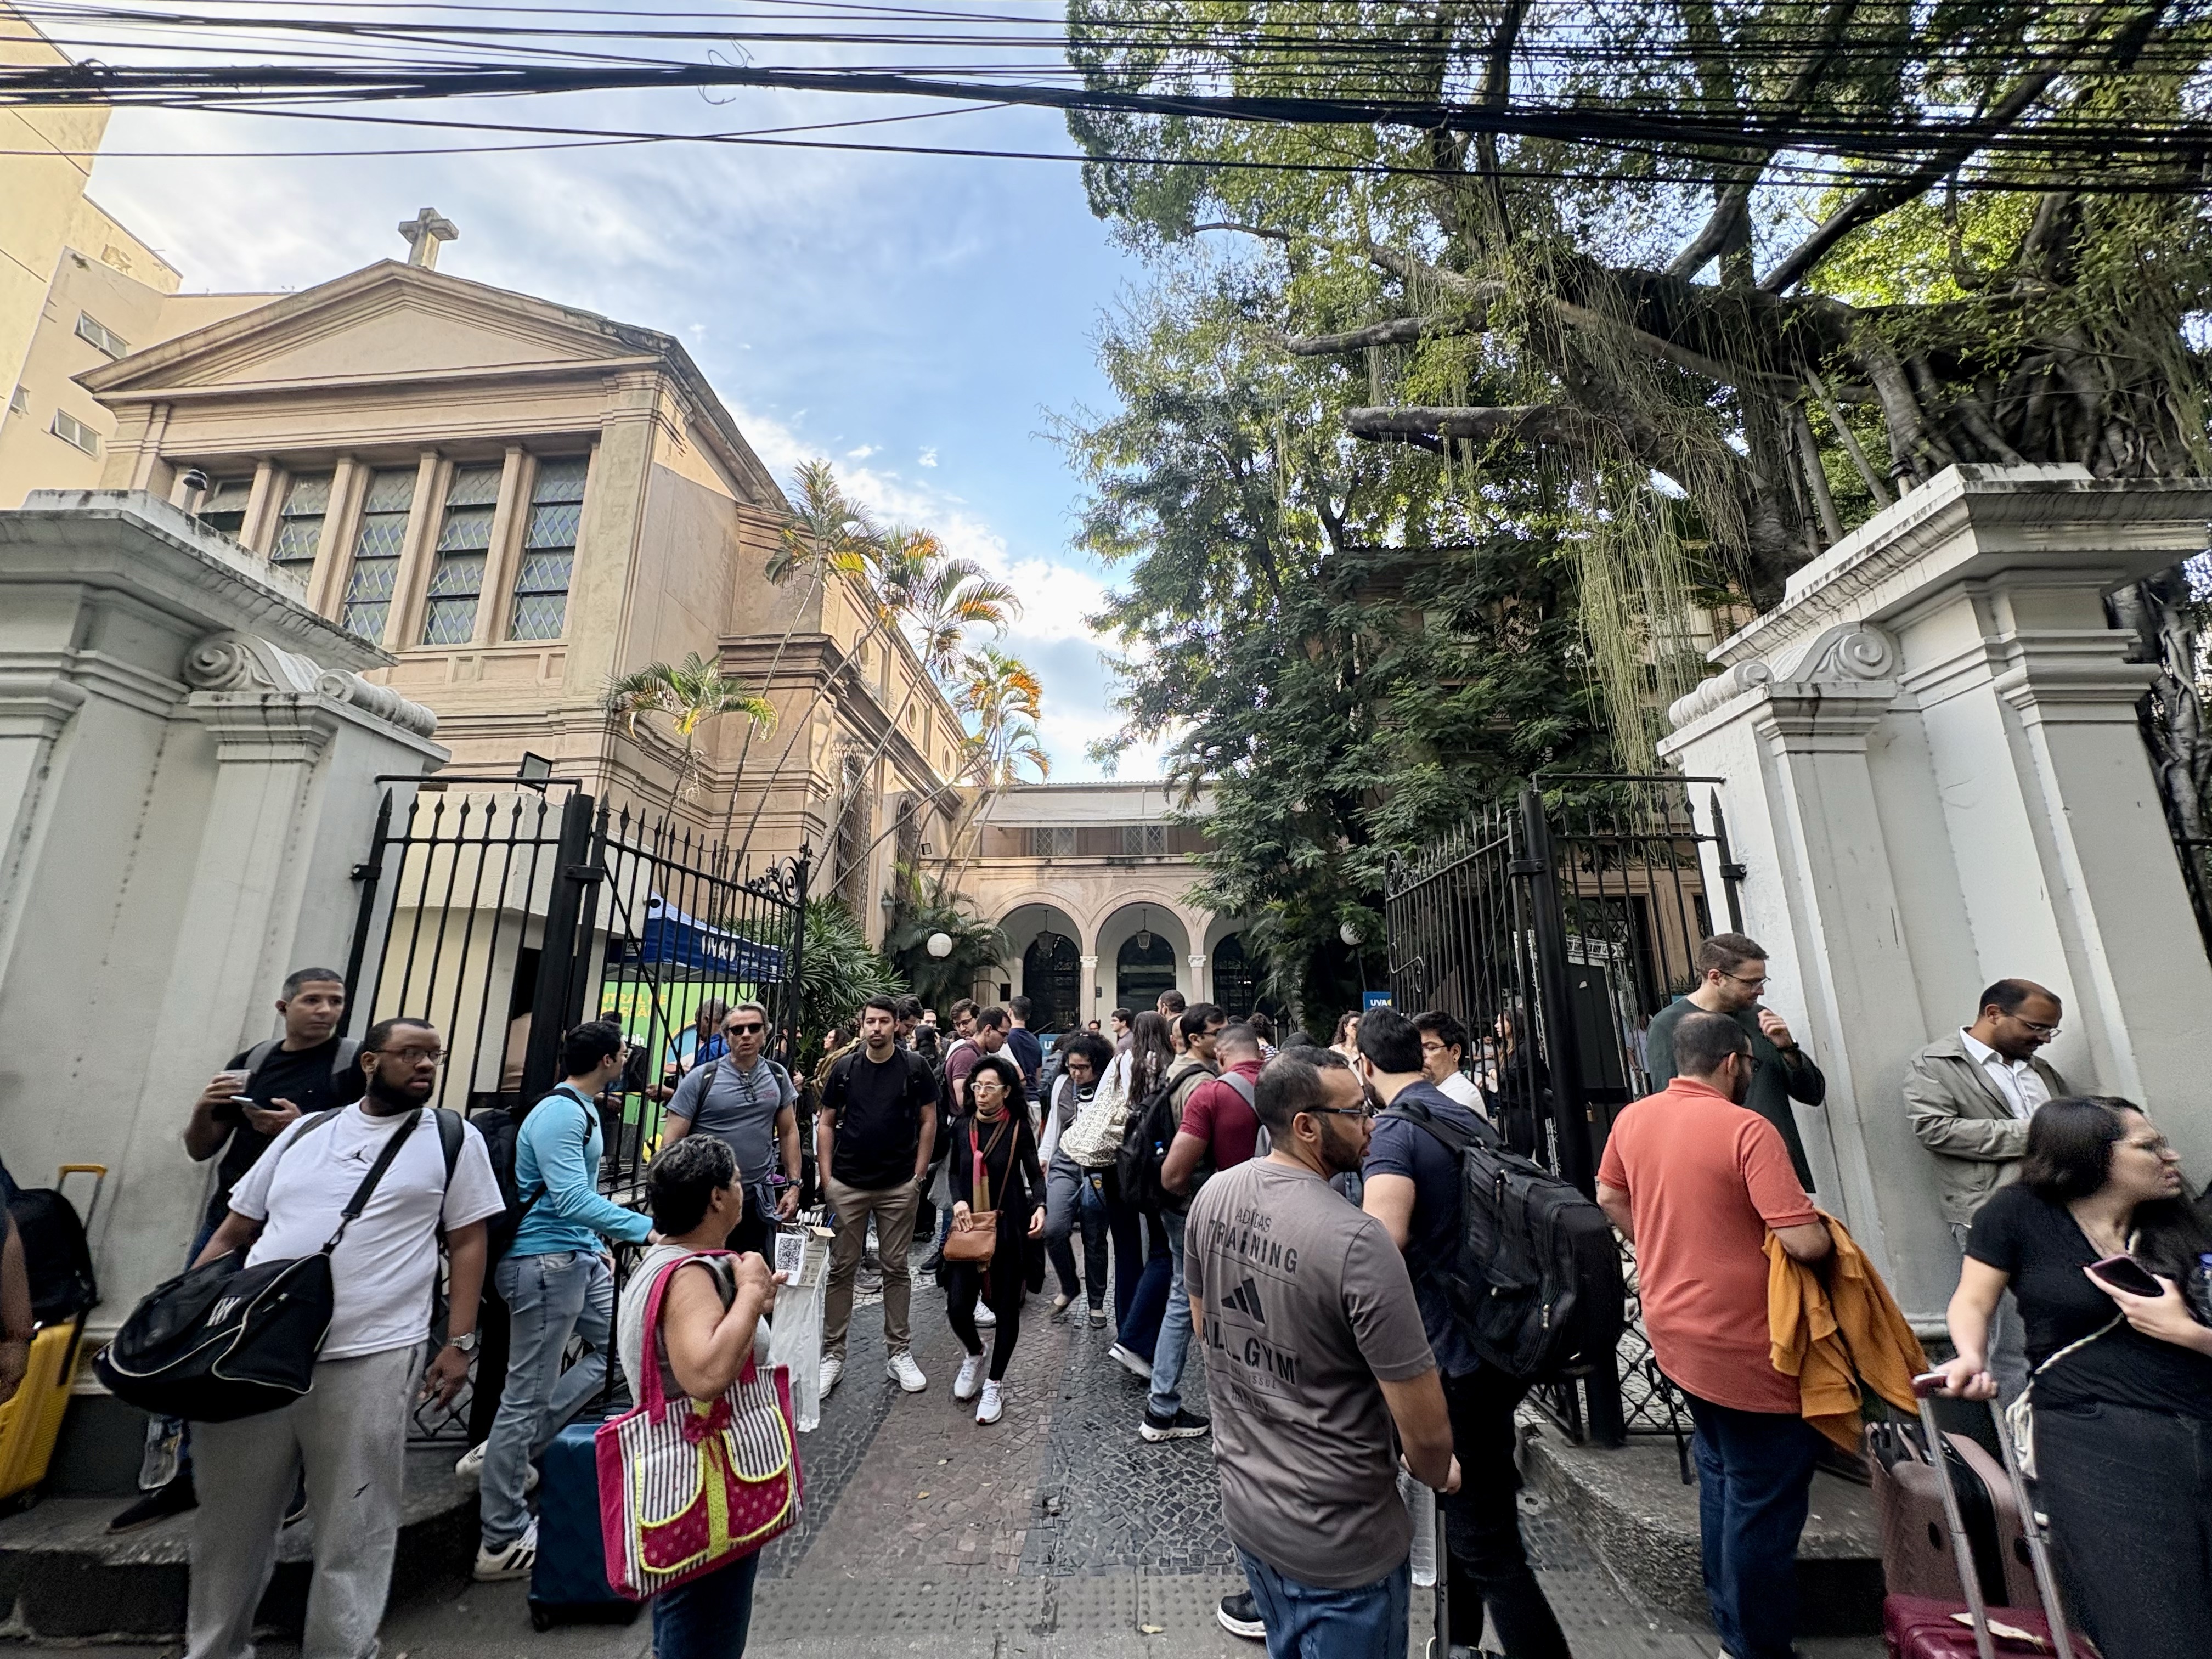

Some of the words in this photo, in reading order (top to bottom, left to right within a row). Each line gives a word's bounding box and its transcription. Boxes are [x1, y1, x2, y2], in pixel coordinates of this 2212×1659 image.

[1234, 1207, 1272, 1233] ADIDAS
[1209, 1219, 1298, 1274] TRAINING
[1244, 1337, 1296, 1386] GYM
